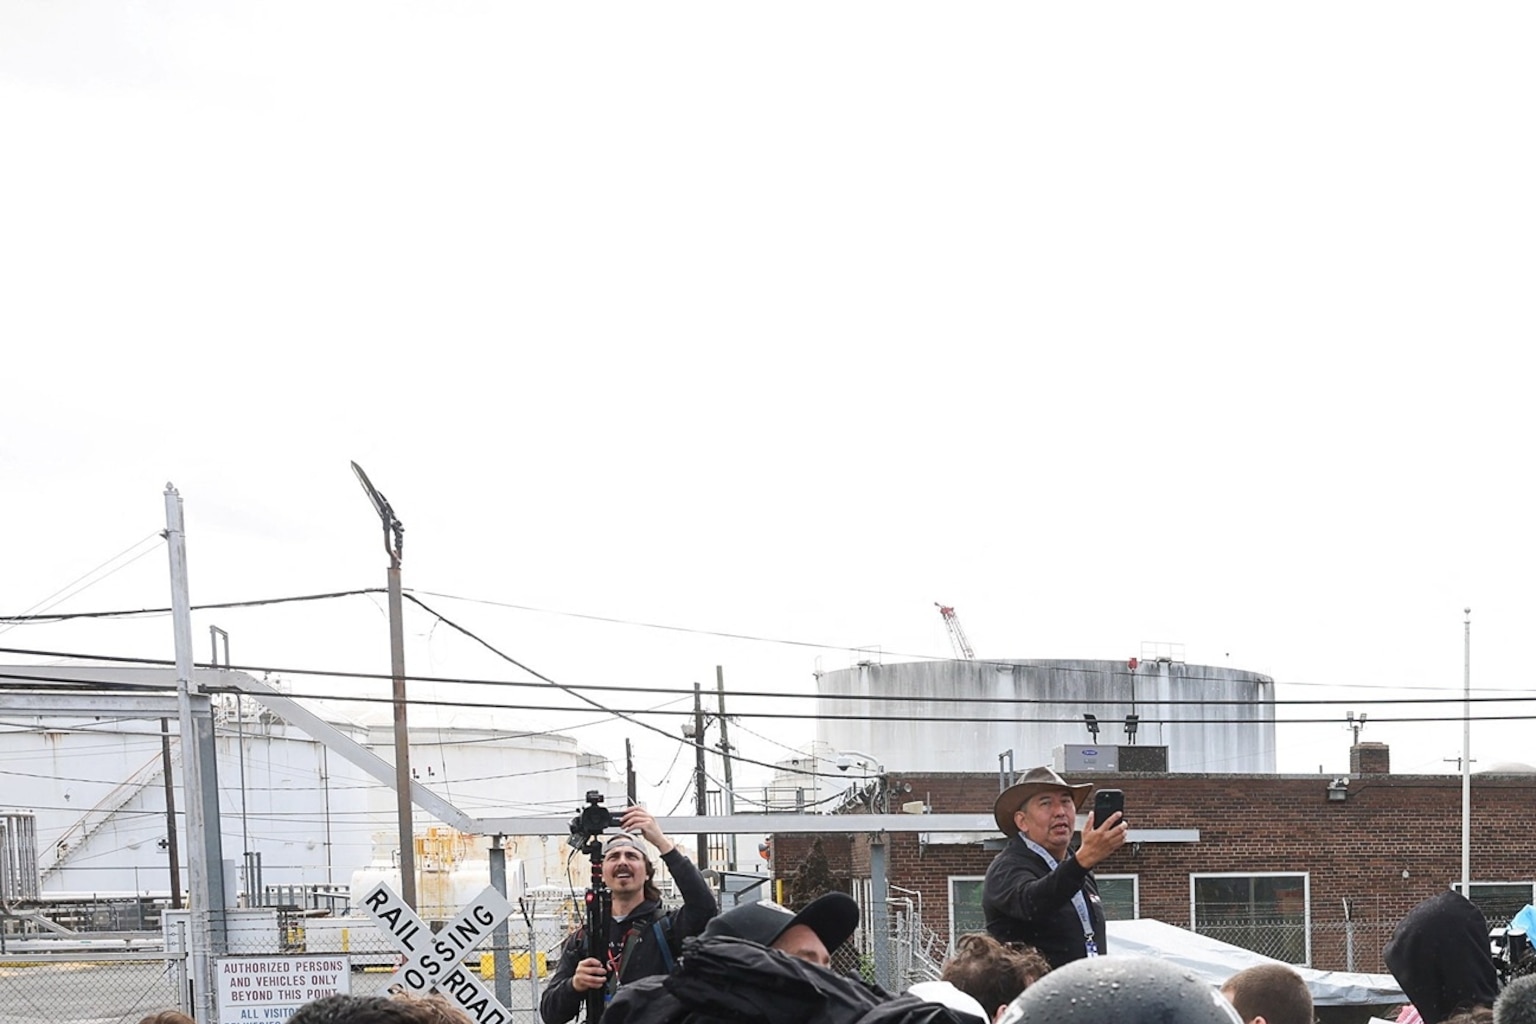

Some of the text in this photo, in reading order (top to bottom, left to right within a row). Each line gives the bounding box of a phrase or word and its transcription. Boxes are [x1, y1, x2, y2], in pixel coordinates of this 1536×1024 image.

[365, 888, 420, 952] RAIL
[224, 961, 343, 973] AUTHORIZED PERSONS
[230, 975, 338, 987] AND VEHICLES ONLY
[231, 990, 273, 1001] BEYOND
[278, 989, 301, 1000] THIS
[241, 1007, 300, 1019] ALL VISITO
